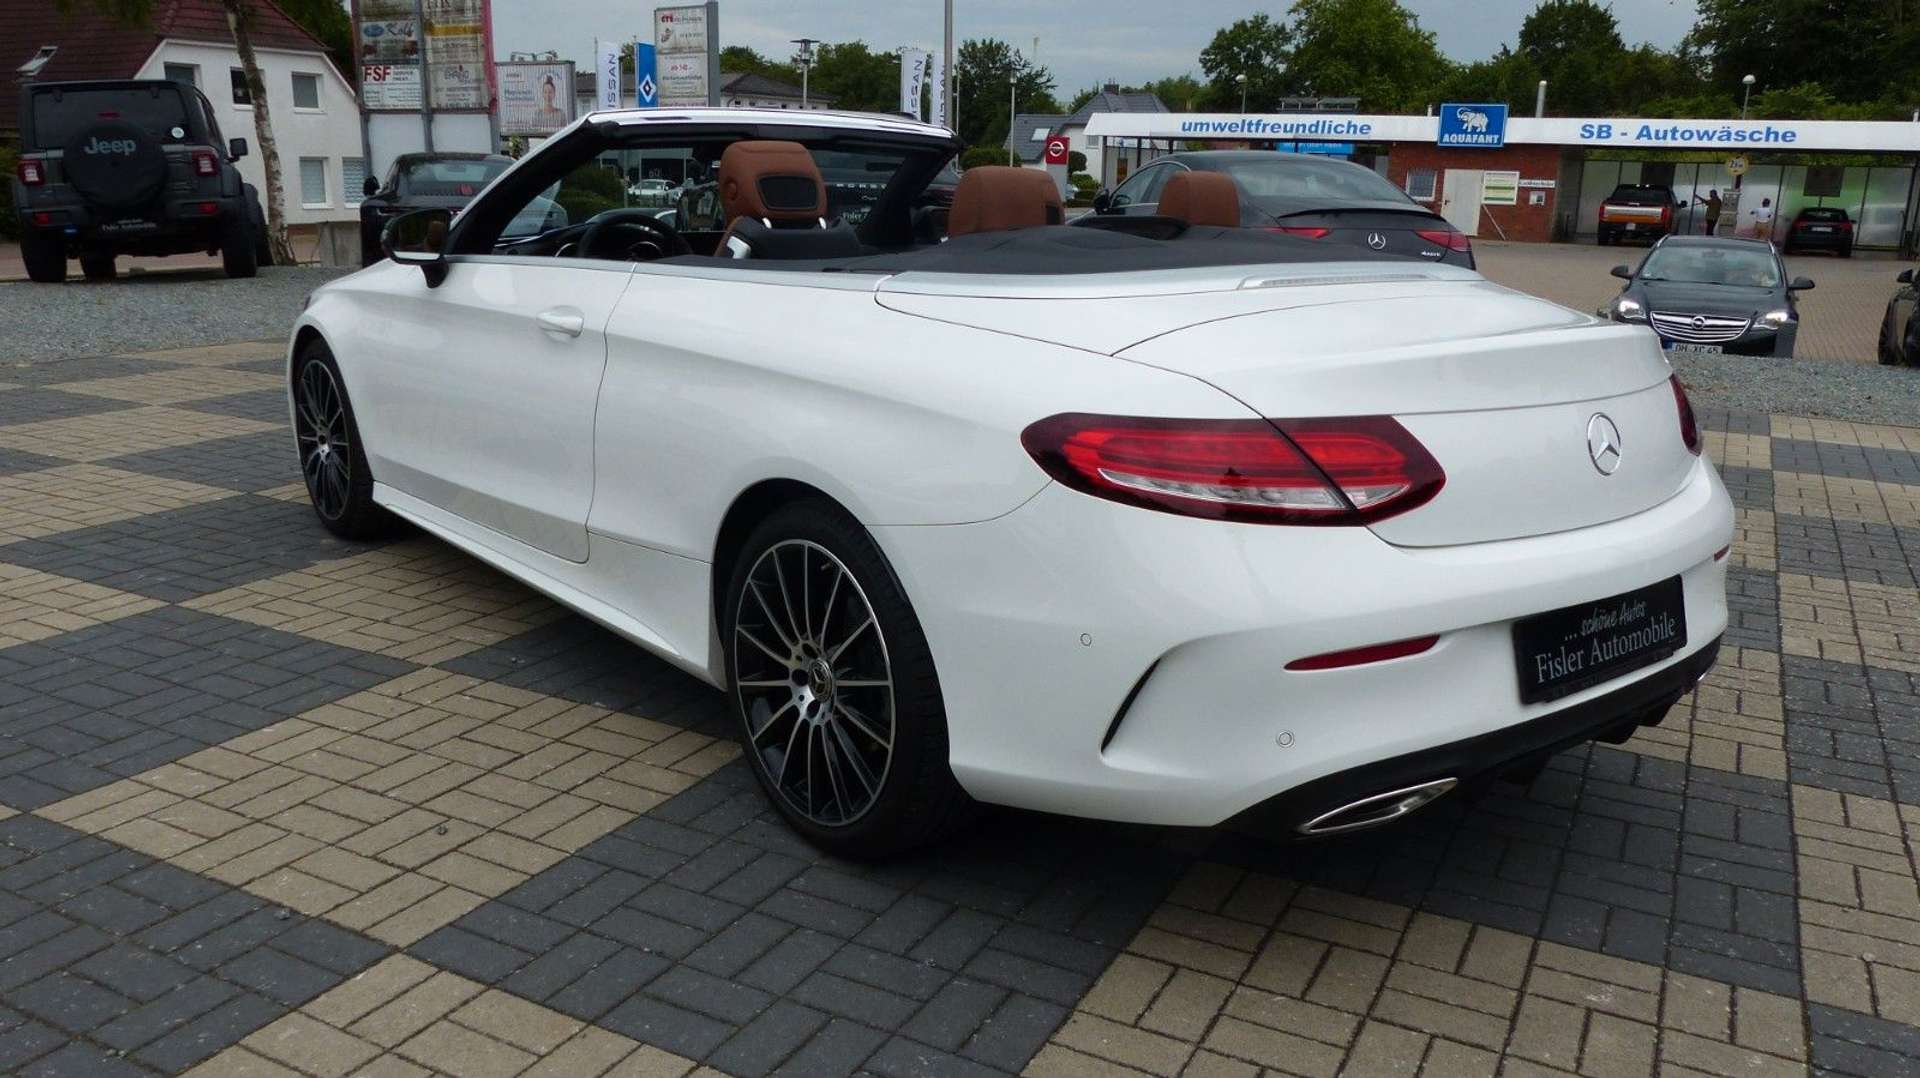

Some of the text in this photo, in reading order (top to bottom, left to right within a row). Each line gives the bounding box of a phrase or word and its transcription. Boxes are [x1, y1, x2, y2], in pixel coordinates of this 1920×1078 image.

[363, 66, 391, 81] FSF
[607, 53, 617, 109] ISSAN
[1181, 118, 1372, 135] umweltfreundliche
[1579, 123, 1612, 139] SB
[1636, 125, 1797, 143] Autowäsche
[84, 136, 137, 156] Jeep
[1442, 133, 1500, 144] AQUAFANT
[1535, 612, 1677, 684] Fisler Automobile
